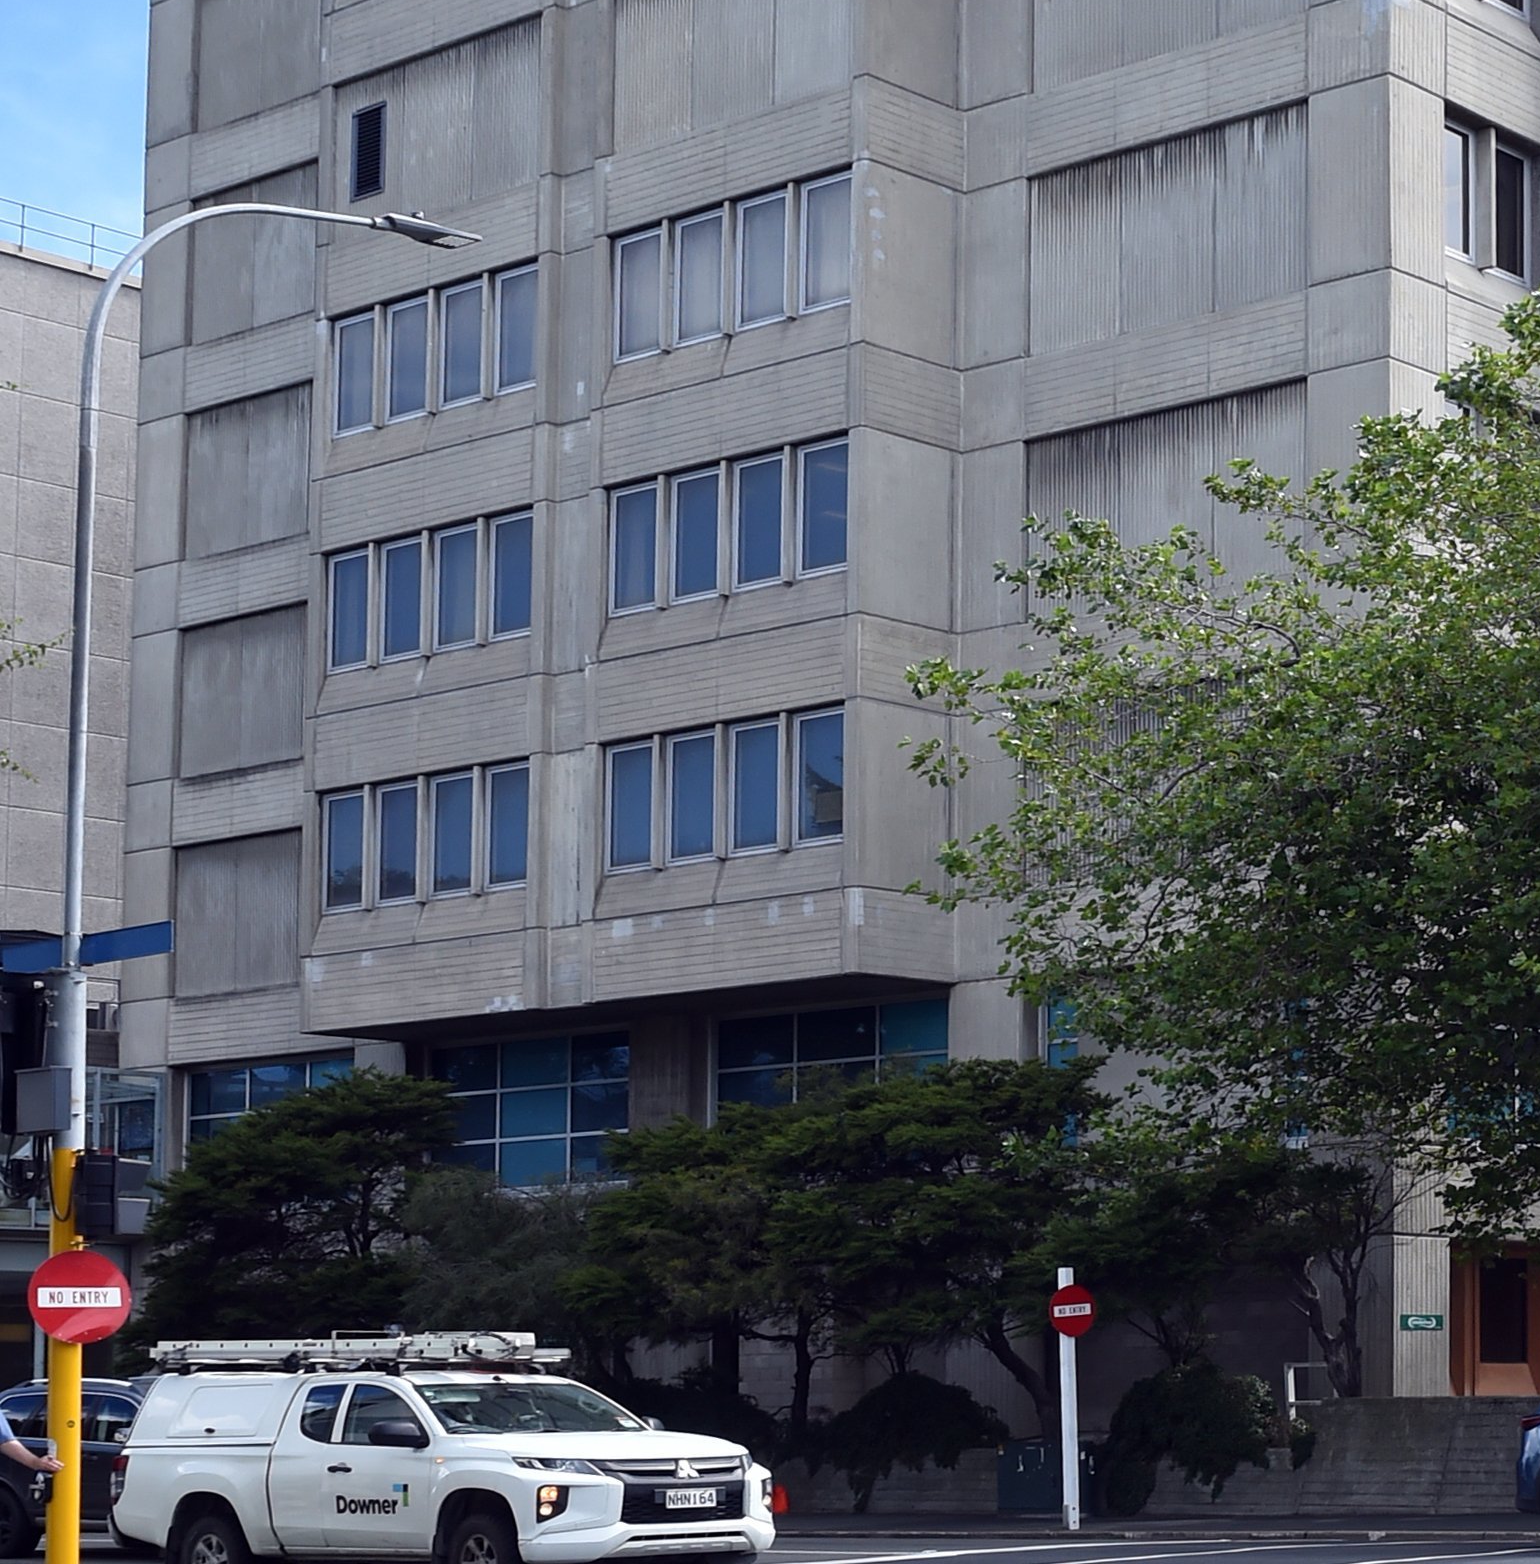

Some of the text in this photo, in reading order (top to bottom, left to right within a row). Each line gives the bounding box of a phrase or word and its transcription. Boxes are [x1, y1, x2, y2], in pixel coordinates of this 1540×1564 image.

[48, 1291, 109, 1304] NO ENTRY
[336, 1495, 398, 1514] Downer
[668, 1492, 714, 1506] NHN164
